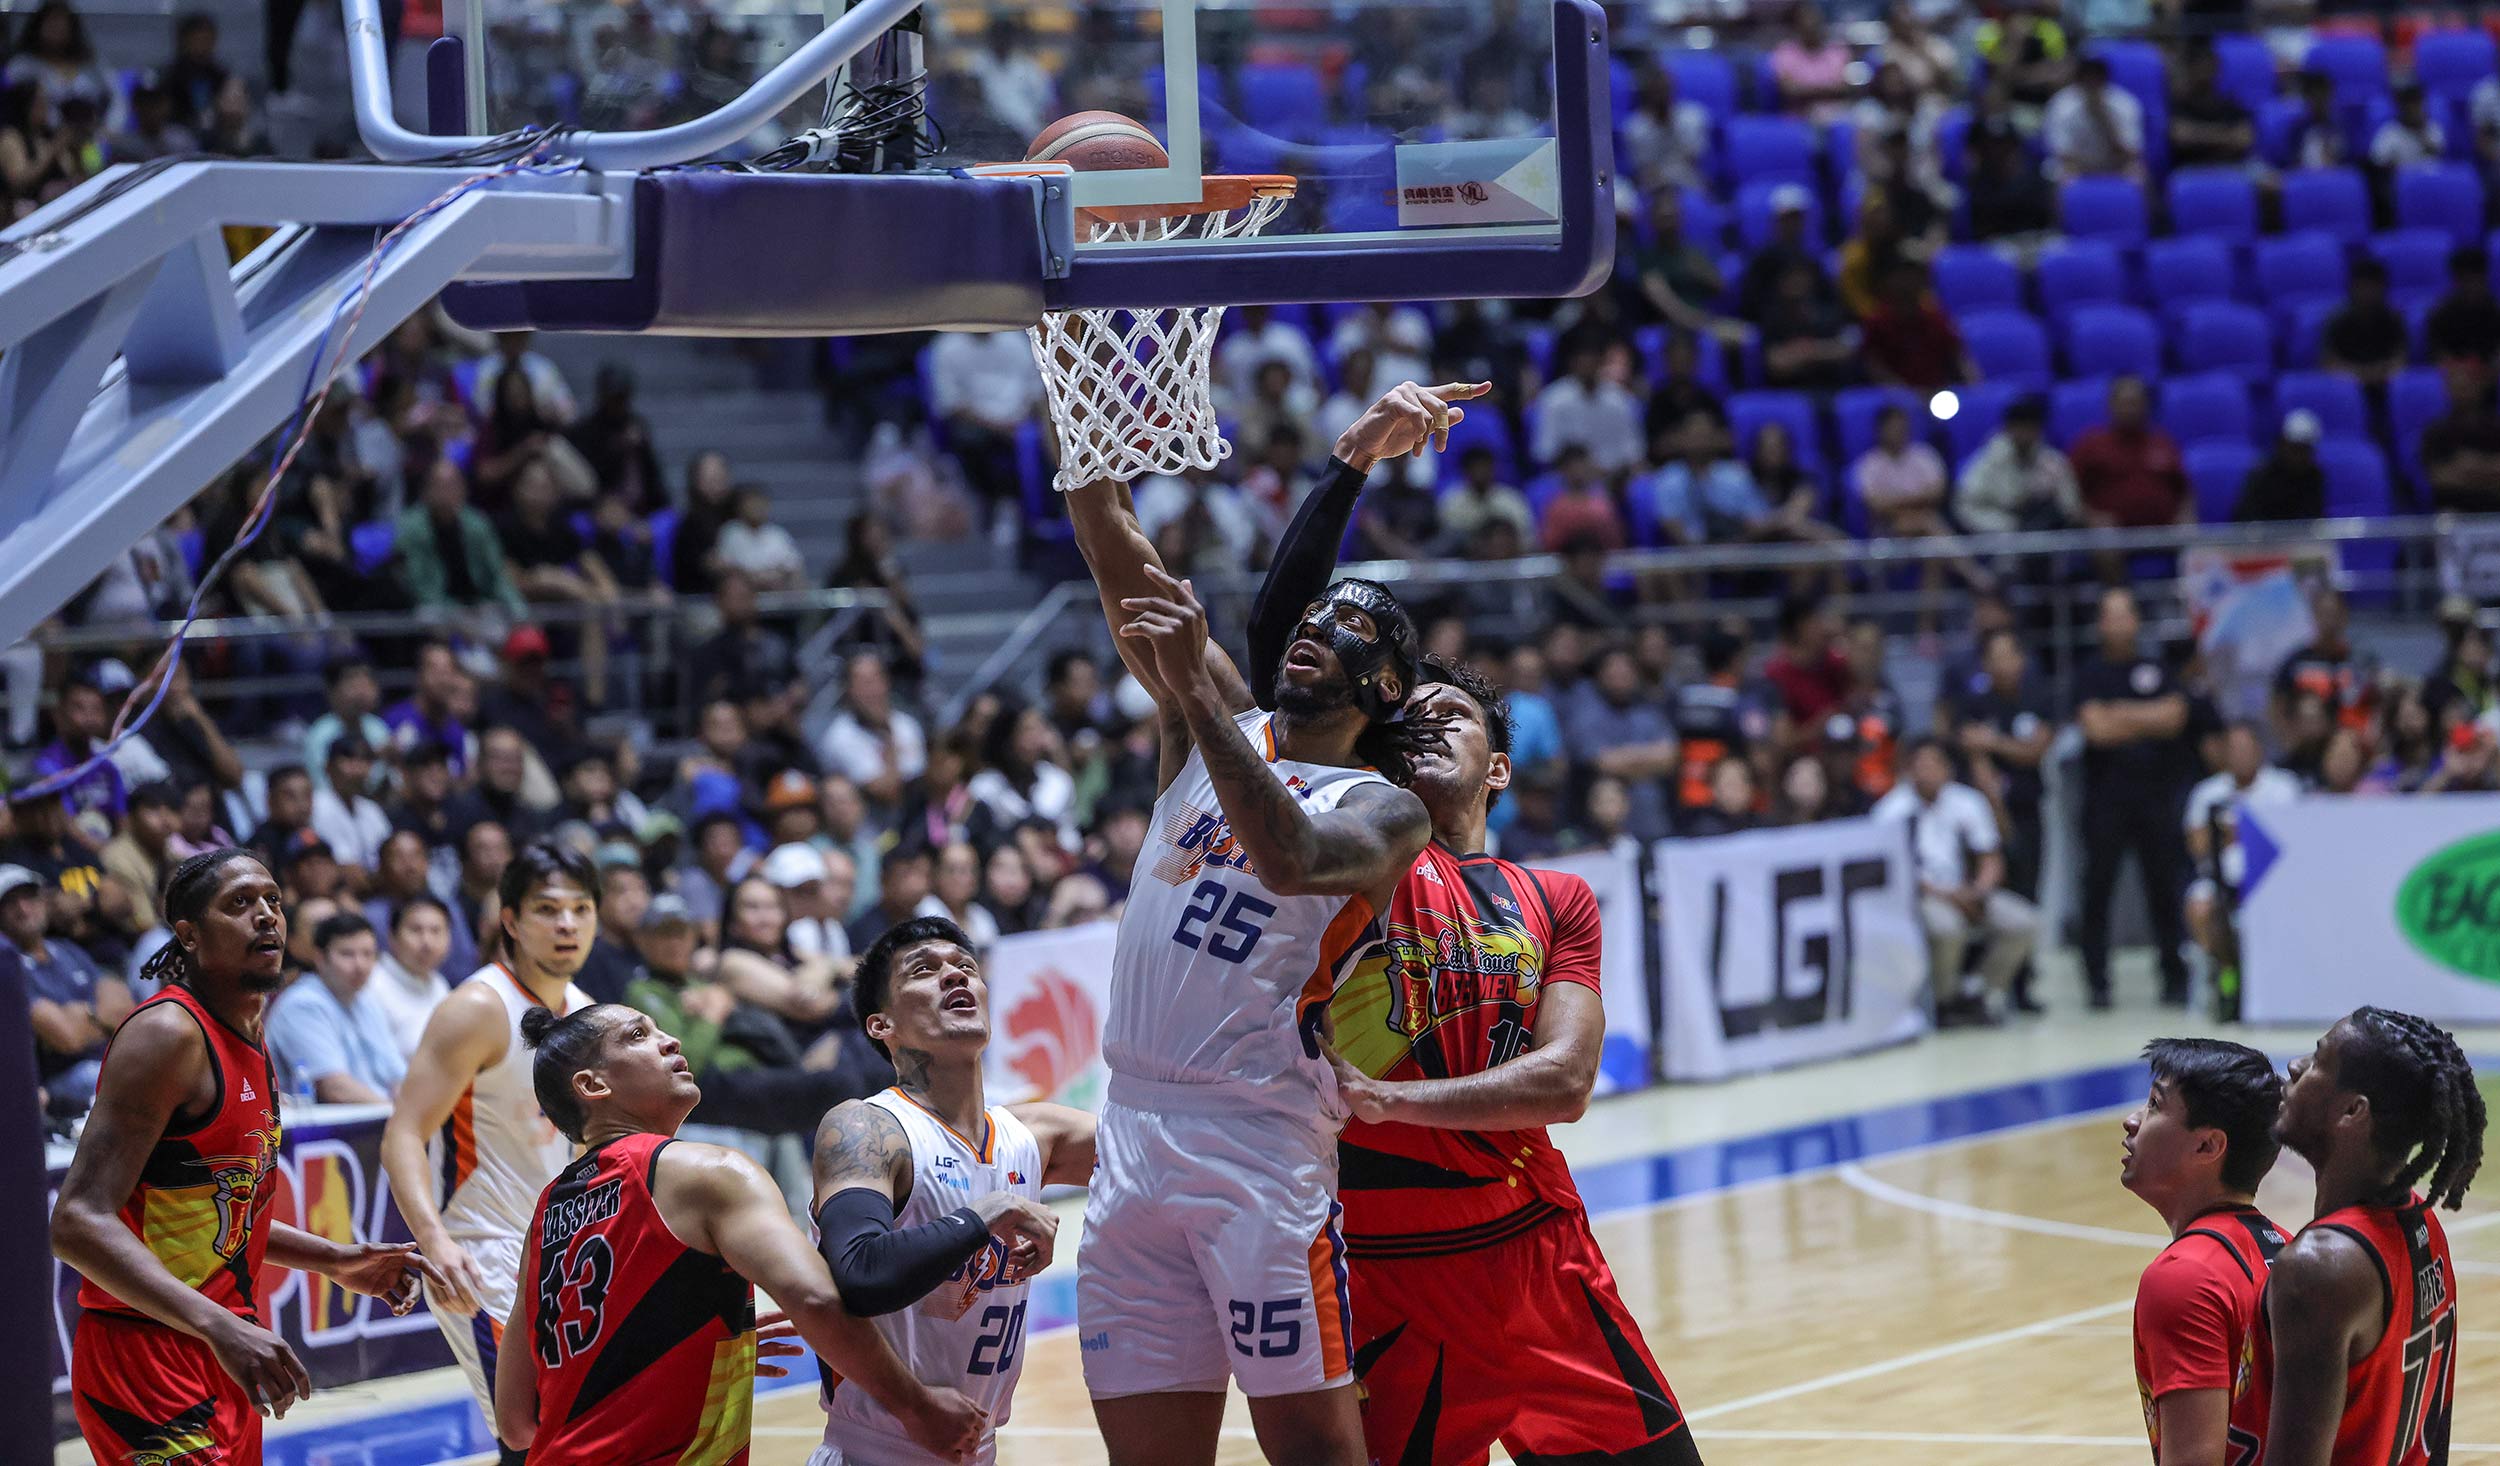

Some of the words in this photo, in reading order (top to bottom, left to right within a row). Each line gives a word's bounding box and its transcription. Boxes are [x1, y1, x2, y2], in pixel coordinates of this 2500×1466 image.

[1172, 879, 1278, 964] 25
[541, 1178, 623, 1249] LASSITER
[540, 1233, 614, 1369] 13
[967, 1299, 1028, 1376] 20
[1228, 1298, 1302, 1358] 25
